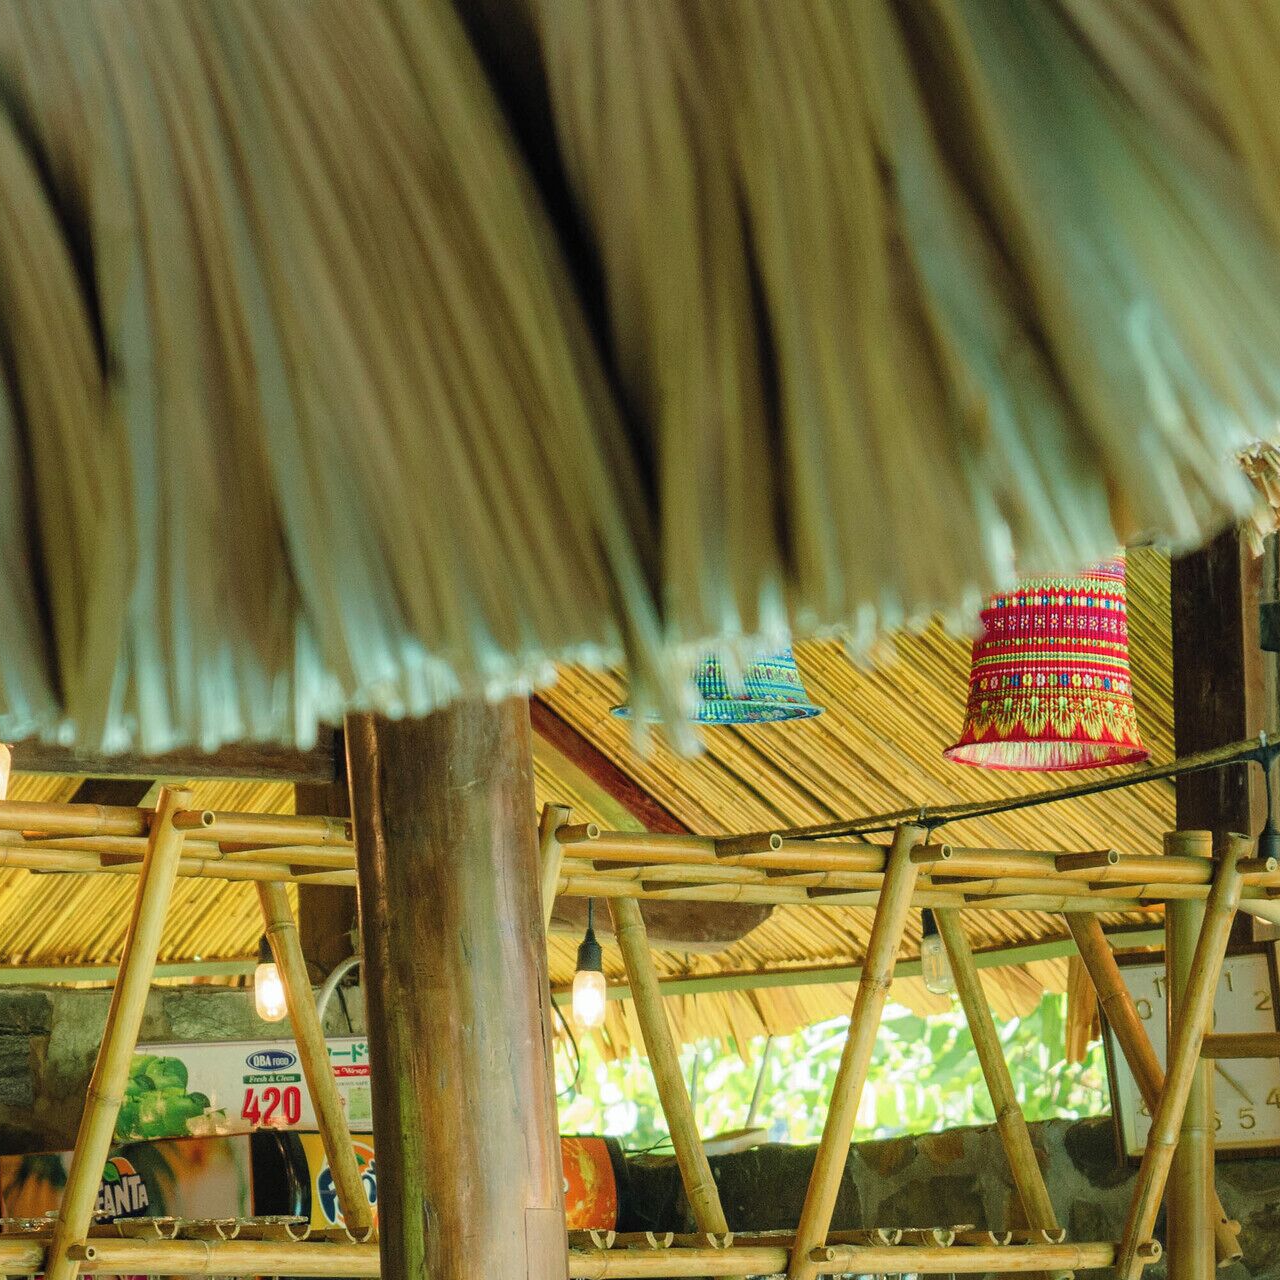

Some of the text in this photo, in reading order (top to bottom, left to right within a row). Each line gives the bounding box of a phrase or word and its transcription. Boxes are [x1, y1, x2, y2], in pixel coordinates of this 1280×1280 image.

[1224, 970, 1233, 992] 1
[1254, 990, 1273, 1011] 2
[272, 1057, 290, 1066] FOOD
[241, 1086, 301, 1126] 420
[1239, 1108, 1256, 1130] 5
